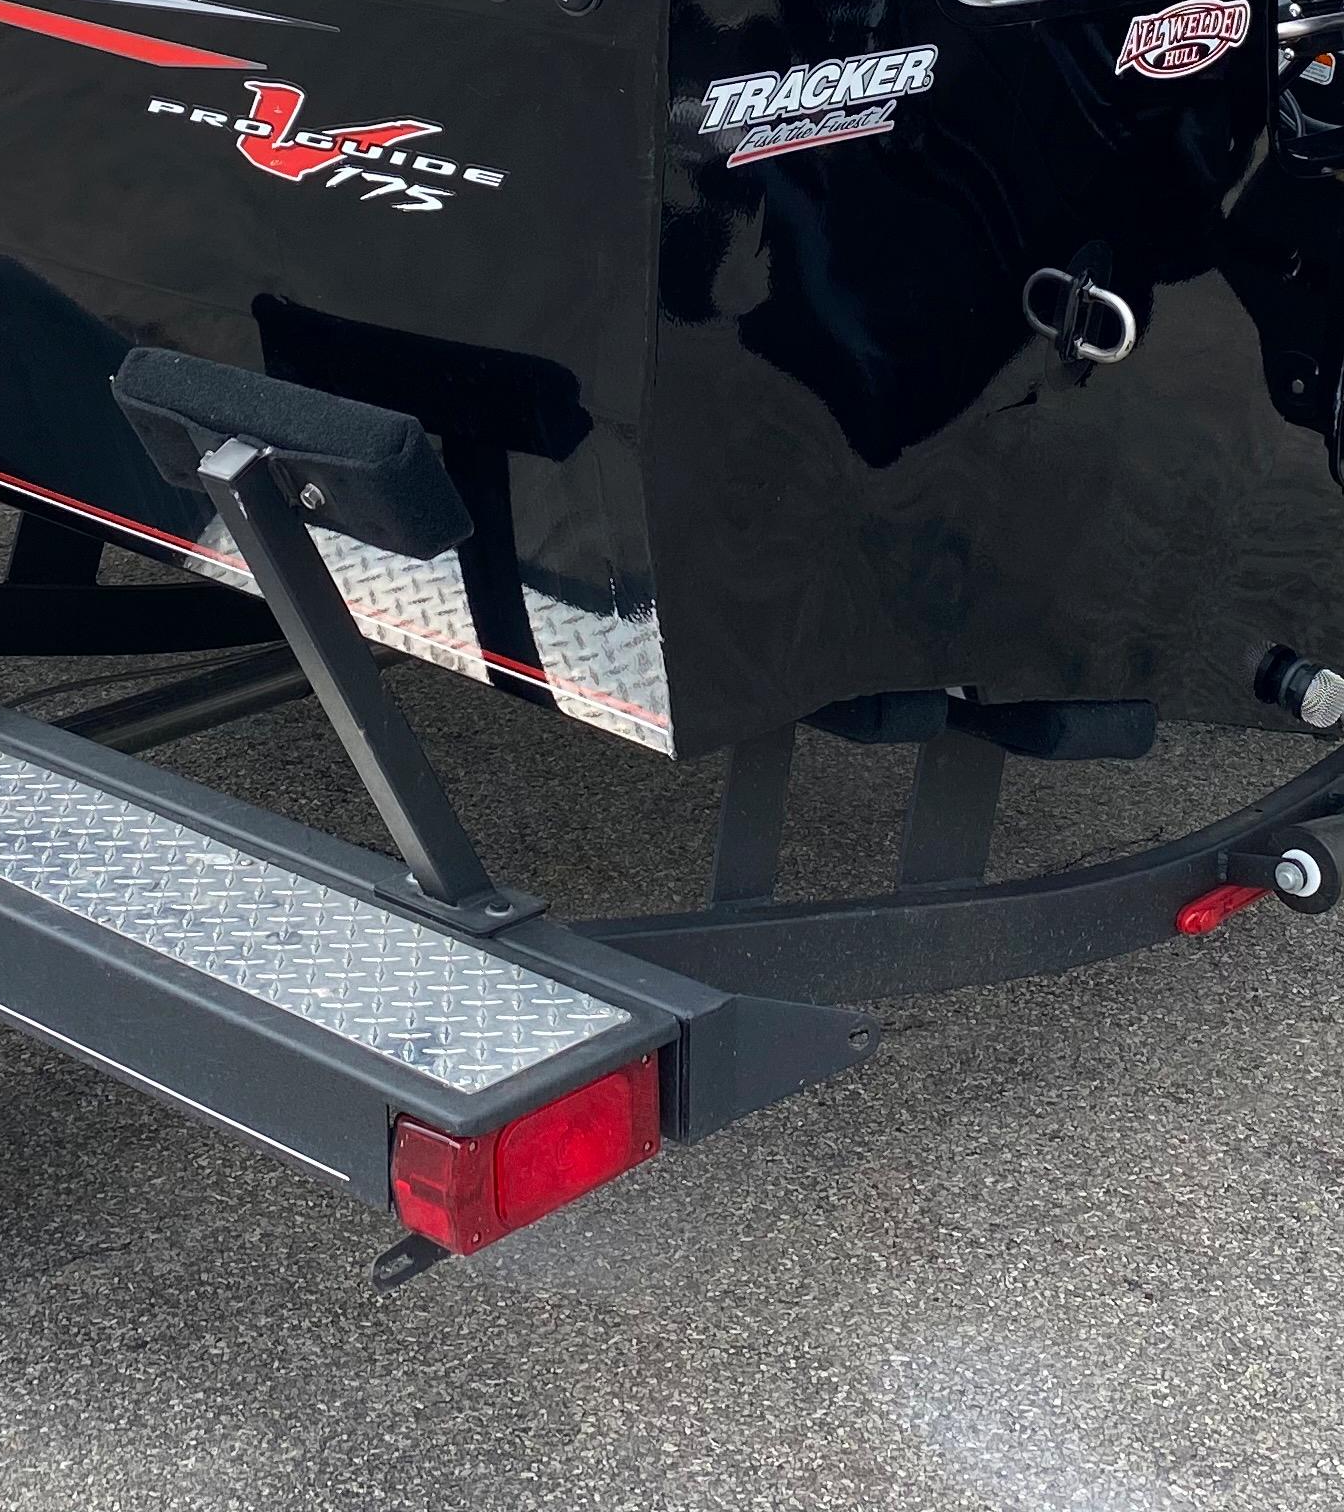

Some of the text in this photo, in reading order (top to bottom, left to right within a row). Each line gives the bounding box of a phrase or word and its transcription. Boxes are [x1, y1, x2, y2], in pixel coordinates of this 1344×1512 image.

[1121, 4, 1248, 62] ALL WELDED
[1162, 45, 1201, 68] HULL
[703, 48, 936, 130] TRACKER
[739, 124, 783, 152] Fish
[783, 122, 812, 141] the
[325, 164, 456, 212] 175
